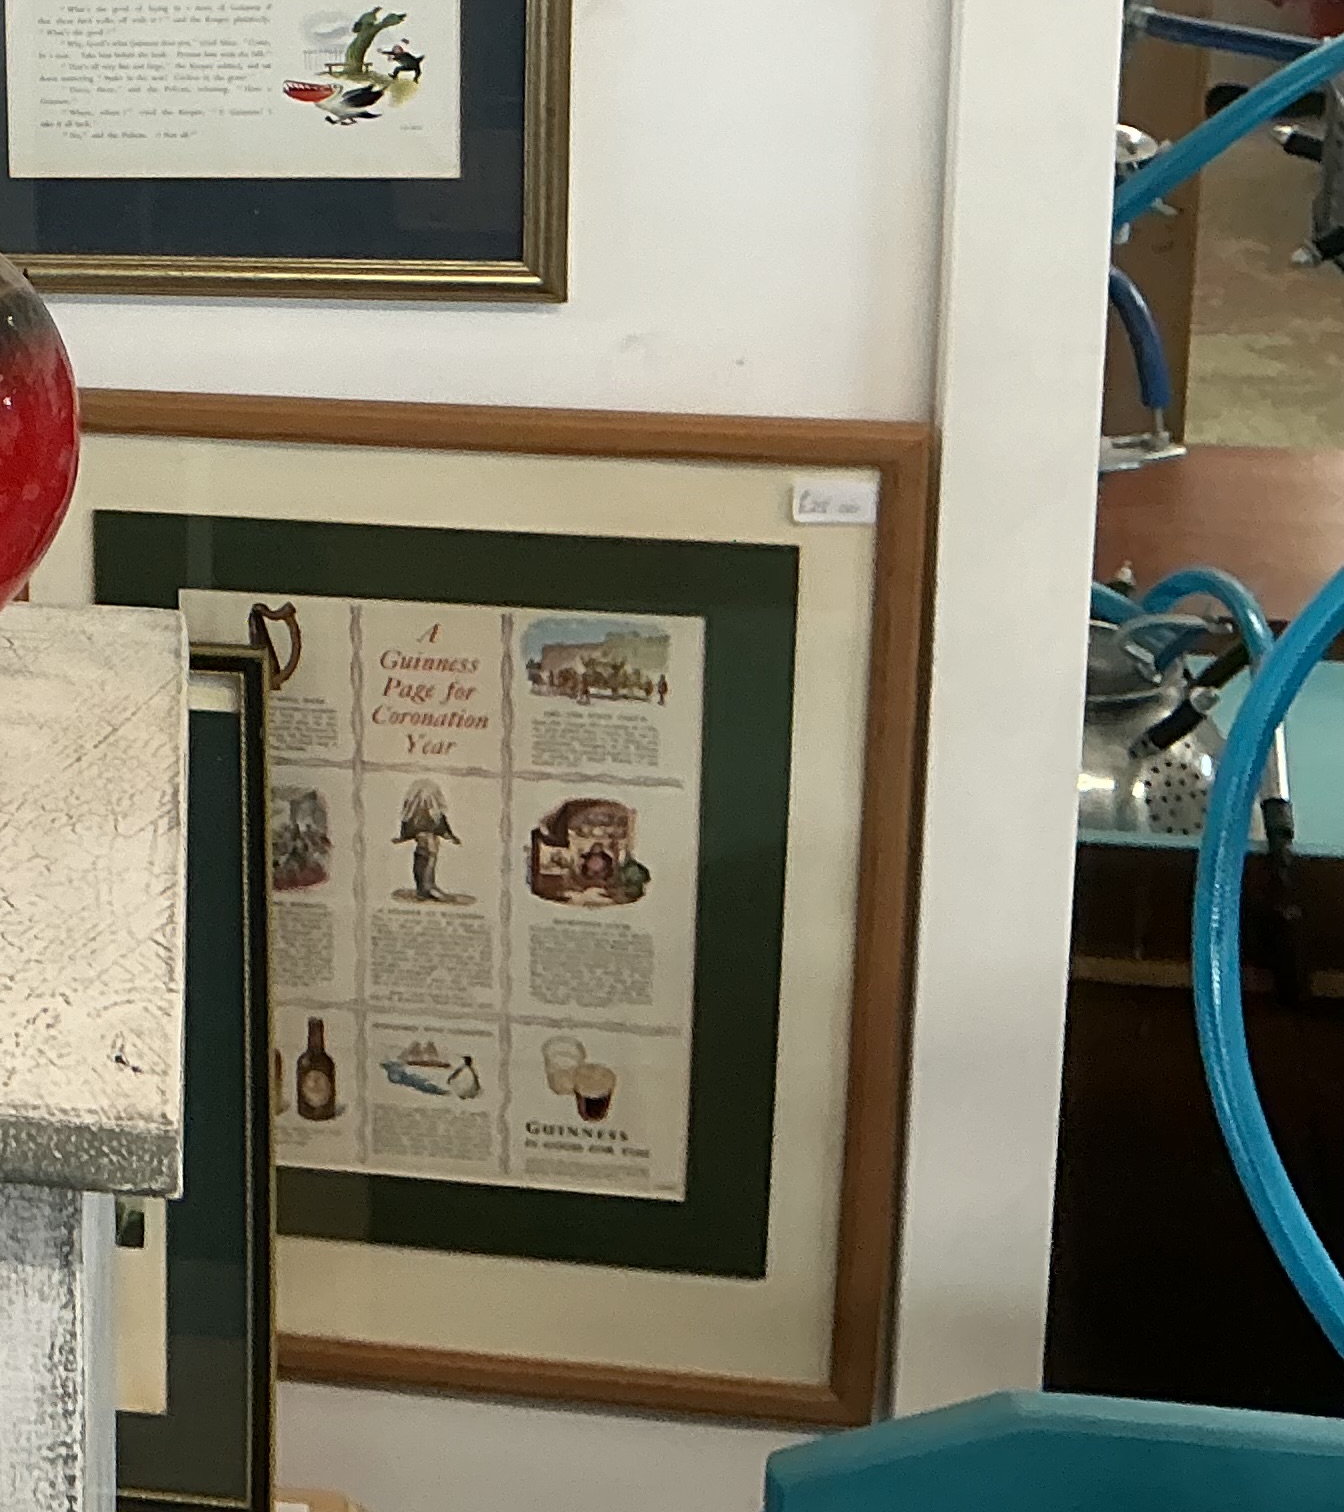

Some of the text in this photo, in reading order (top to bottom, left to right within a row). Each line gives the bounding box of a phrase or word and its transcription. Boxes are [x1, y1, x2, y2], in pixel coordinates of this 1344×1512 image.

[417, 622, 441, 643] A
[380, 649, 480, 673] Guinness
[383, 677, 476, 705] Page for
[372, 705, 489, 729] Coronation
[406, 733, 456, 755] Year
